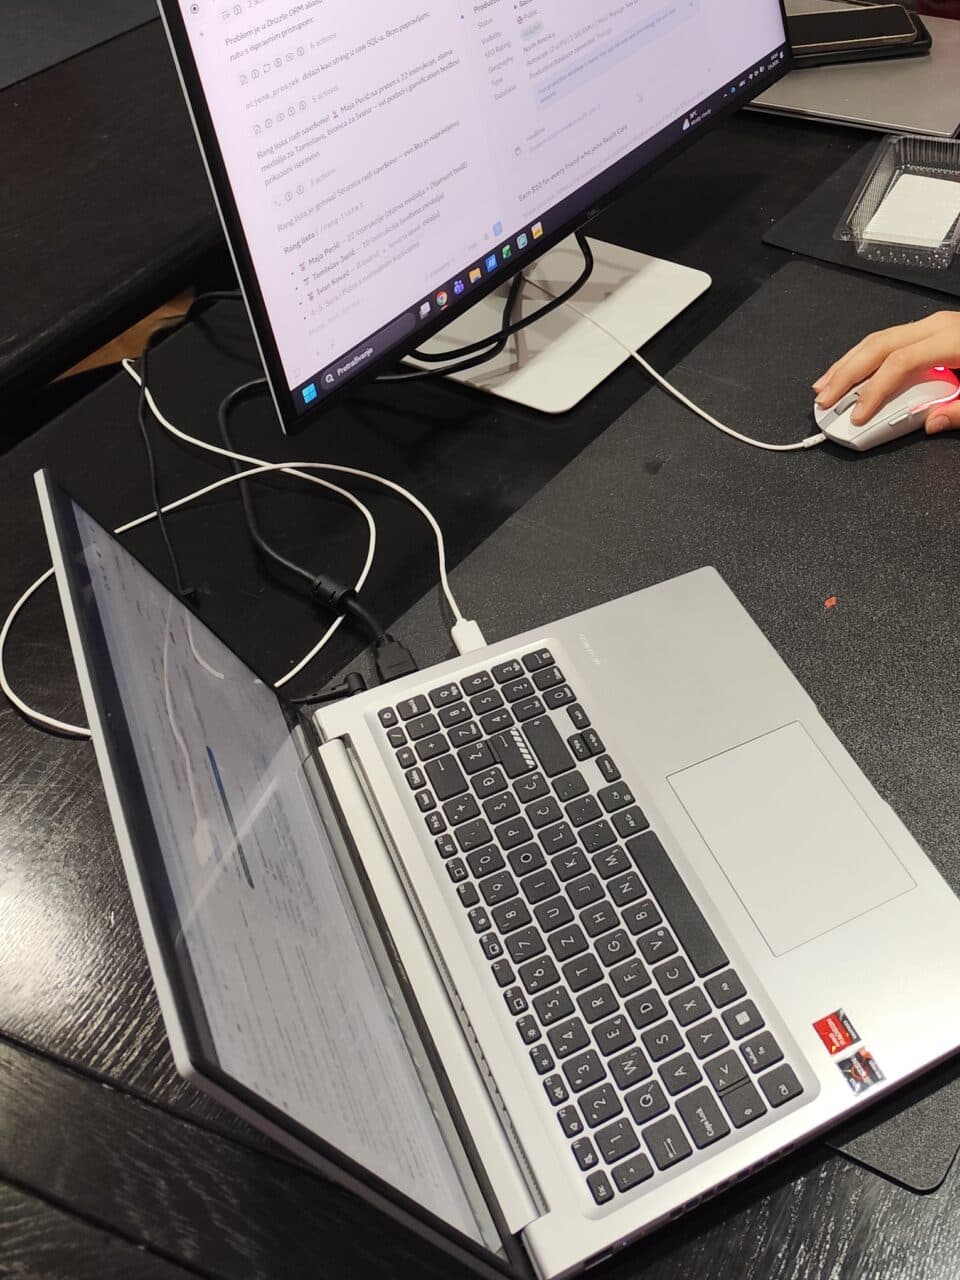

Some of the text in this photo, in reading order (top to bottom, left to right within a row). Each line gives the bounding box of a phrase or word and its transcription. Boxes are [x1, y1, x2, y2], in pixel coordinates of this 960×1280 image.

[225, 28, 253, 47] Problem
[253, 25, 261, 35] je
[316, 32, 336, 46] actions
[257, 146, 275, 162] Rang
[284, 231, 315, 257] Rang lista
[308, 252, 324, 268] Maja
[502, 665, 513, 673] 3
[471, 677, 482, 685] 6
[512, 684, 523, 692] 2
[439, 690, 450, 698] 9
[553, 691, 564, 699] 0
[480, 696, 492, 704] 5
[448, 709, 460, 717] 8
[468, 751, 482, 760] Ž
[523, 781, 537, 790] Ć
[493, 802, 507, 811] Š
[535, 805, 550, 815] Č
[507, 829, 520, 837] P
[552, 831, 563, 842] L
[479, 855, 491, 864] 0
[519, 852, 533, 864] O
[564, 857, 577, 868] K
[604, 853, 619, 866] M
[491, 883, 504, 891] 9
[618, 881, 633, 894] N
[504, 909, 517, 919] 8
[546, 907, 560, 919] U
[592, 911, 606, 924] H
[635, 910, 648, 921] B
[517, 941, 531, 949] 7
[560, 935, 575, 947] Z
[607, 939, 621, 952] G
[649, 940, 663, 951] V
[532, 968, 545, 977] 6
[575, 967, 588, 977] T
[622, 973, 637, 982] F
[665, 967, 679, 980] C
[546, 999, 560, 1008] 5
[591, 996, 604, 1008] R
[682, 999, 697, 1011] X
[639, 1002, 653, 1014] D
[561, 1030, 573, 1039] 4
[605, 1028, 620, 1039] E
[655, 1033, 669, 1045] S
[699, 1032, 713, 1043] Y
[576, 1063, 590, 1074] 3
[620, 1059, 637, 1076] W
[673, 1065, 687, 1077] A
[592, 1097, 607, 1109] 2
[638, 1092, 654, 1108] Q
[609, 1134, 622, 1143] 1
